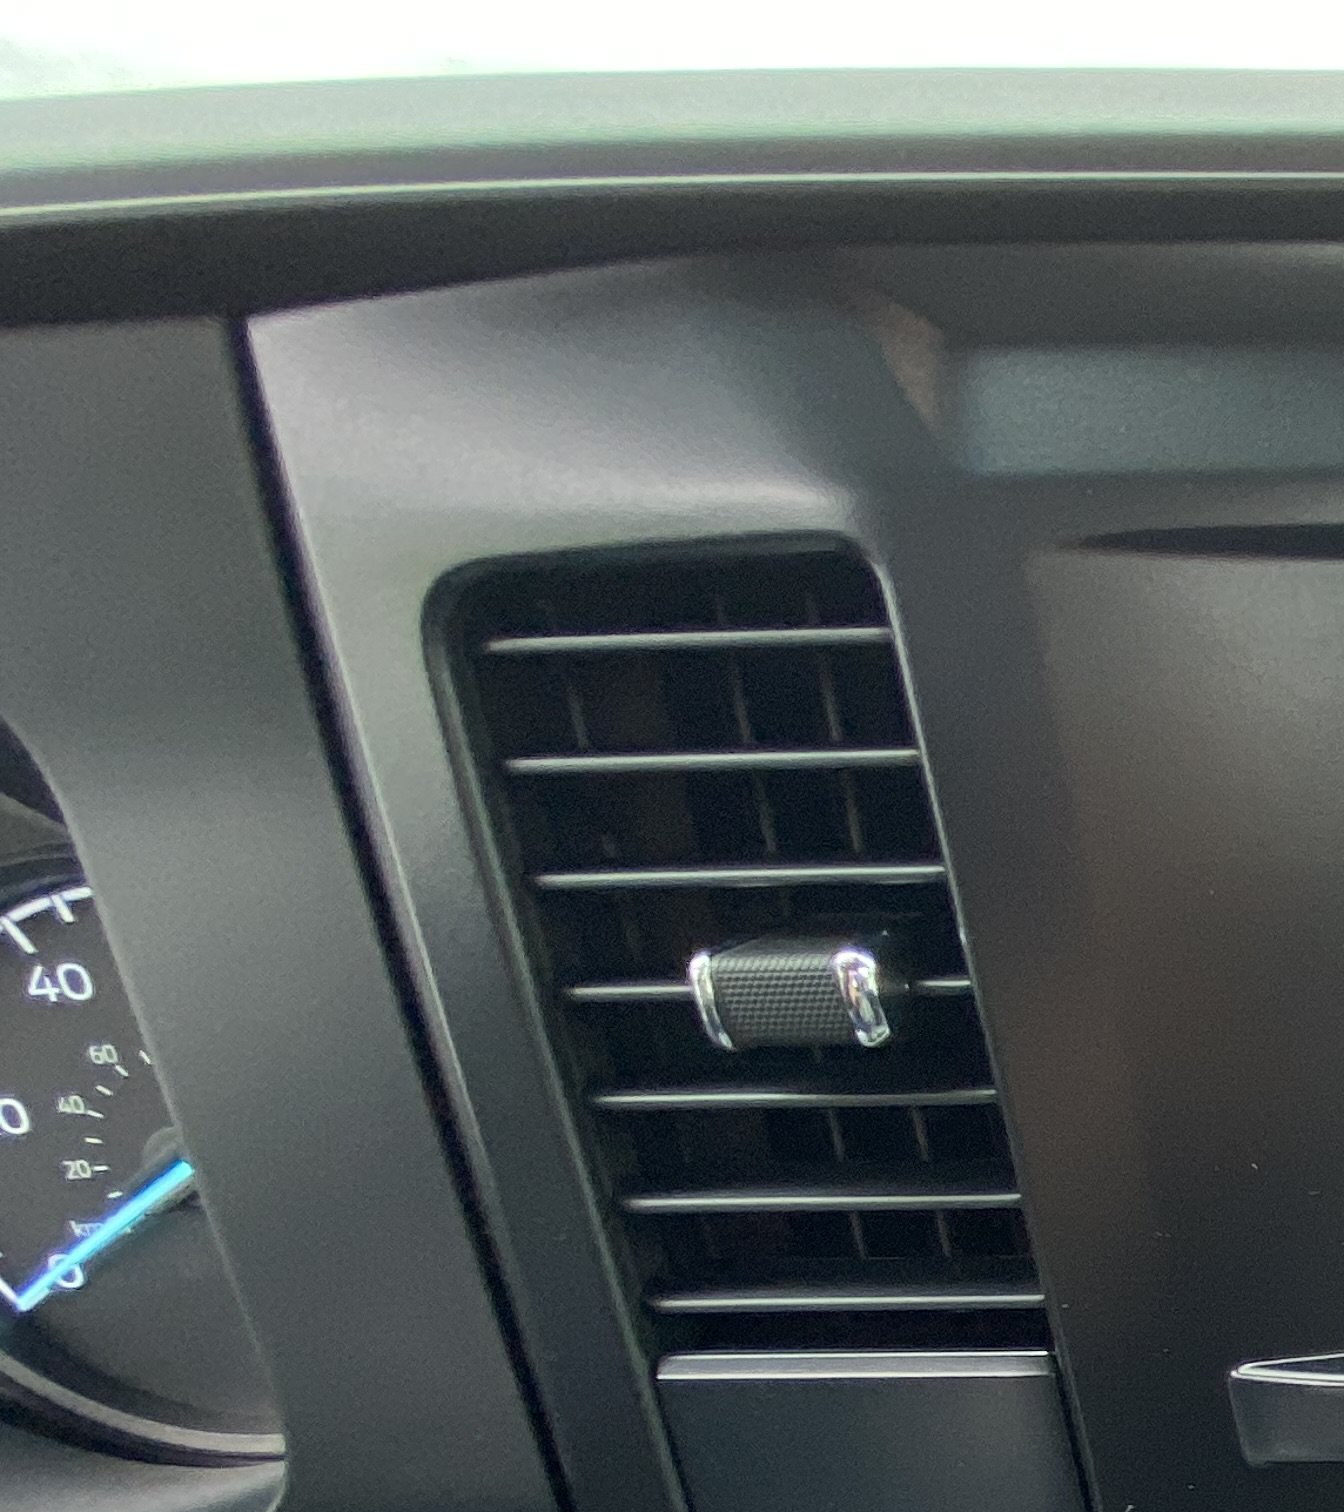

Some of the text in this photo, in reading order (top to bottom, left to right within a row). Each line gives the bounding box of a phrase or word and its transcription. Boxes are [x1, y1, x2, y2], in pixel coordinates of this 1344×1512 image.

[28, 962, 93, 1001] 40
[88, 1044, 118, 1065] 60
[0, 1098, 31, 1134] 0
